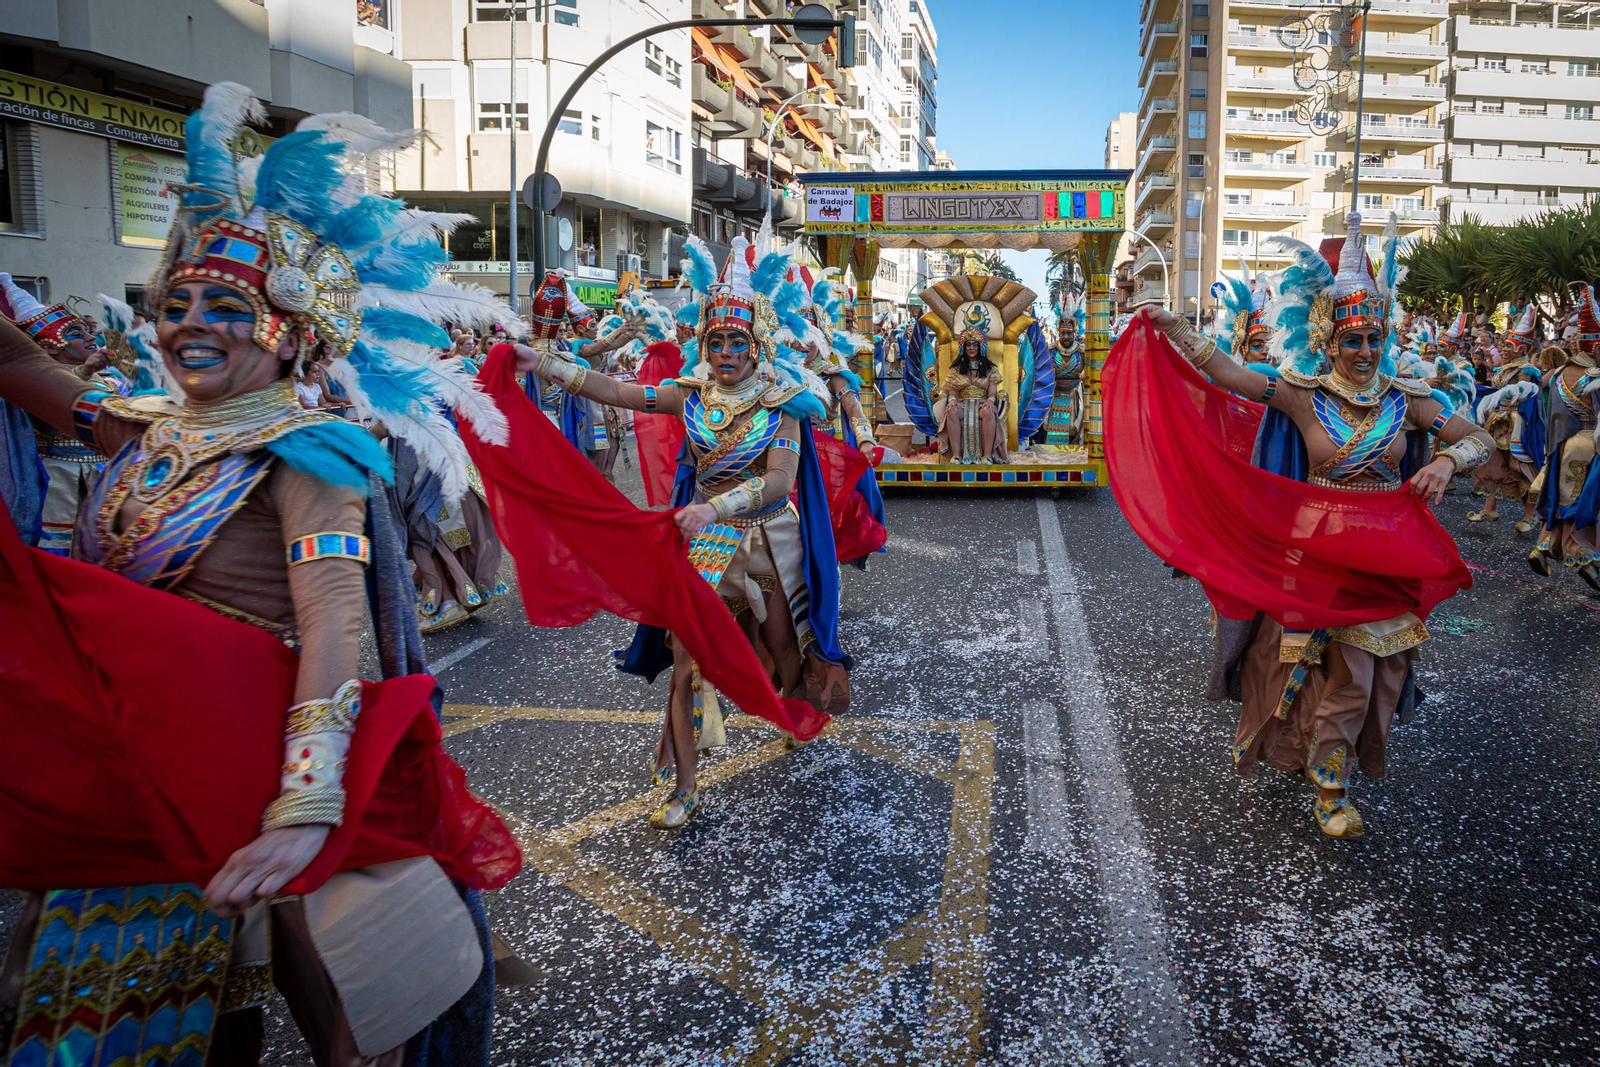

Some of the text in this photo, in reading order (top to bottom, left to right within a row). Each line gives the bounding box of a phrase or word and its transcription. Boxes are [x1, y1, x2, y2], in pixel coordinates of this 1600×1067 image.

[42, 110, 59, 122] de
[60, 112, 96, 130] fincas
[106, 123, 179, 148] Compra-Venta
[124, 173, 157, 185] COMPRA
[126, 199, 170, 212] ALQUILERES
[807, 197, 853, 206] de Badajoz
[126, 212, 168, 223] HIPOTECAS
